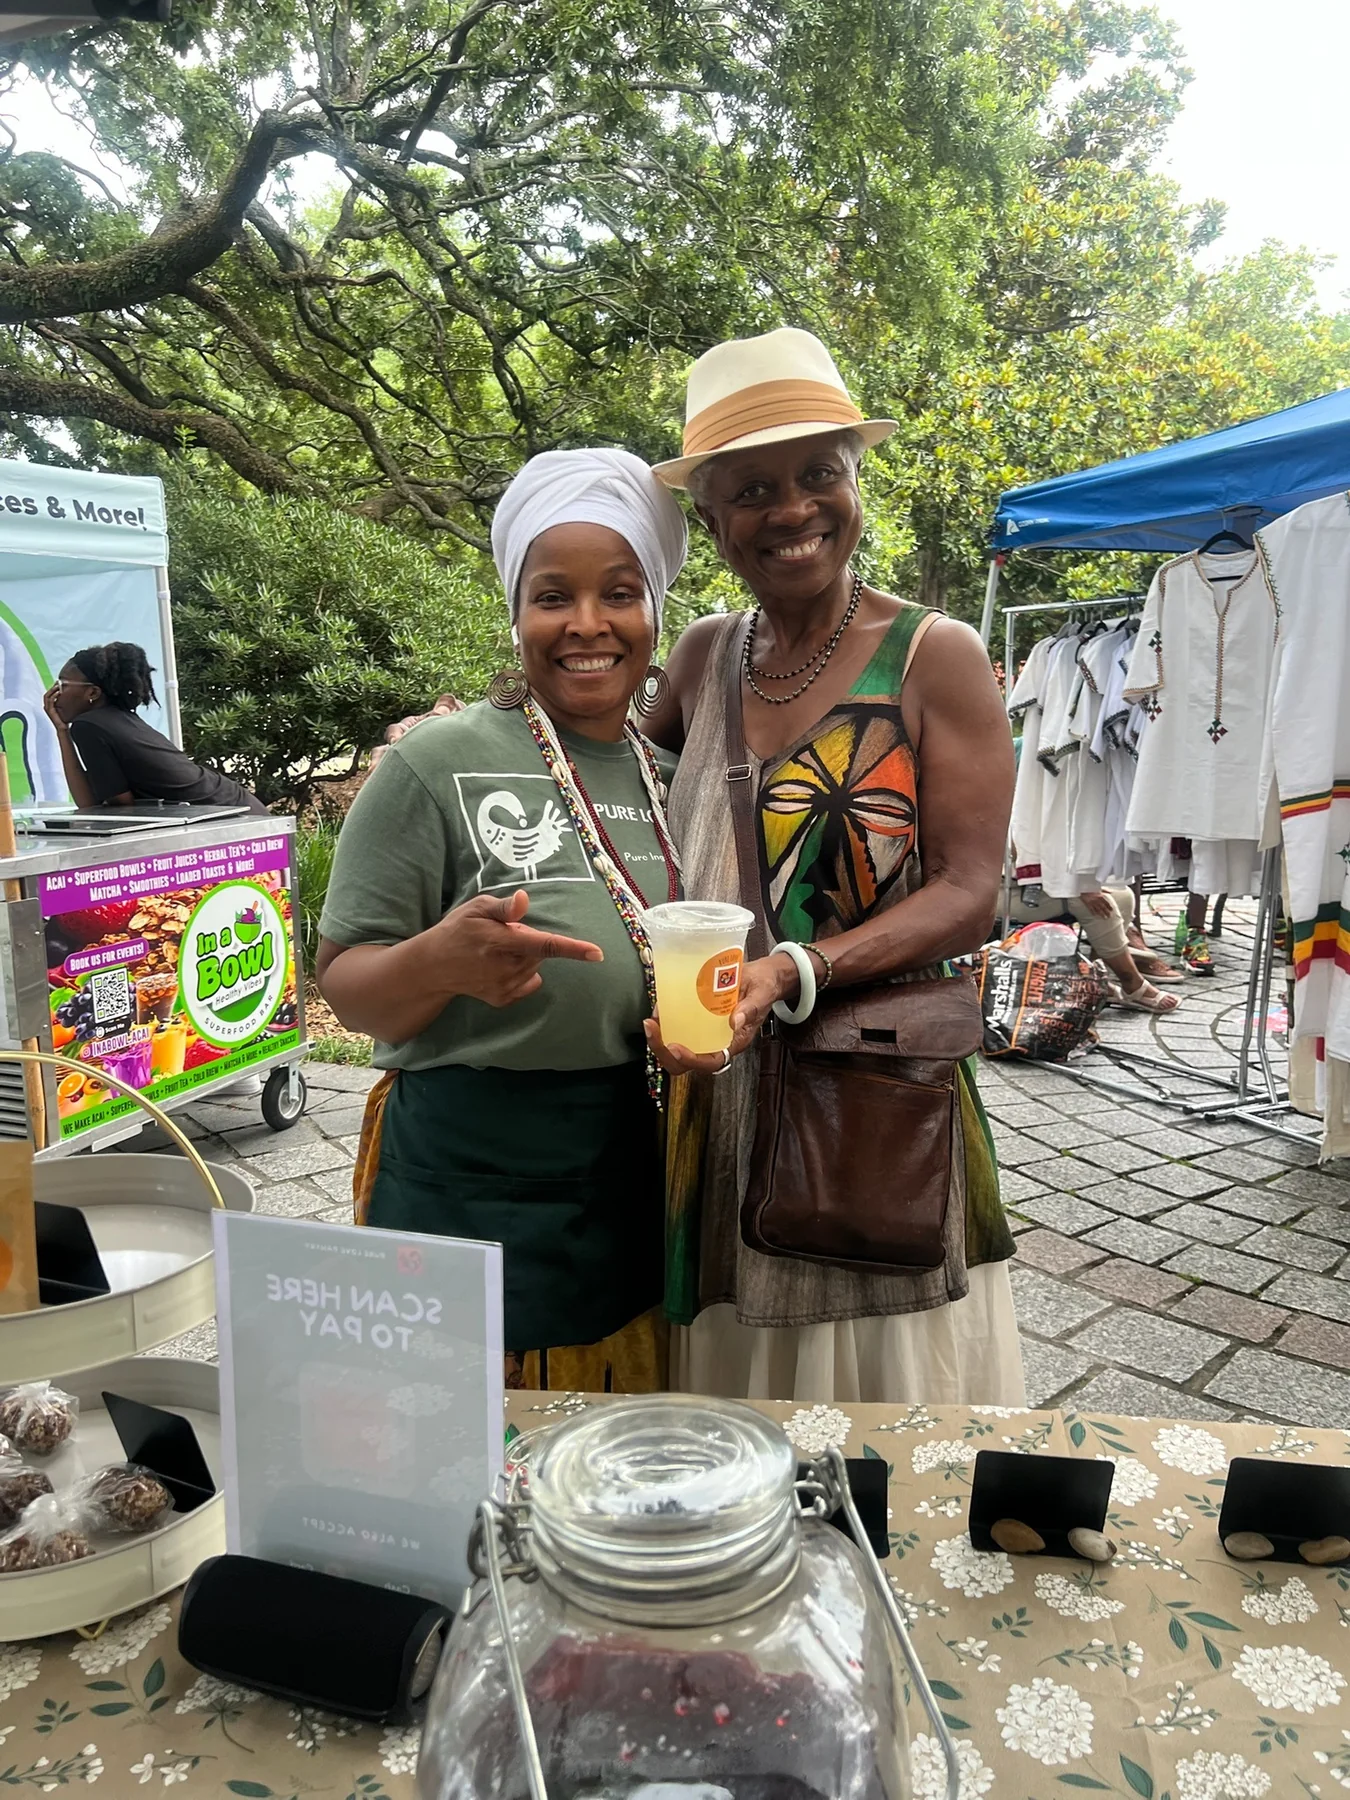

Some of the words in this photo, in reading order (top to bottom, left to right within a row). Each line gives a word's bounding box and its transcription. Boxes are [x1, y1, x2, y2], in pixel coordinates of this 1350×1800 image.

[46, 495, 66, 518] &
[72, 499, 147, 531] More!
[593, 803, 638, 821] PURE
[46, 875, 67, 891] ACAI
[74, 865, 119, 886] SUPERFOOD
[119, 861, 147, 878] BOWLS
[153, 857, 173, 872] FRUIT
[174, 853, 198, 868] JUICES
[203, 848, 228, 863] HERBAL
[624, 852, 648, 862] Pure
[89, 884, 122, 902] MATCHA
[129, 875, 170, 894] SMOOTHIES
[176, 869, 201, 884] LOADED
[202, 865, 226, 879] TOASTS
[228, 862, 233, 874] &
[70, 958, 90, 972] BOOK
[90, 954, 101, 966] US
[102, 950, 116, 963] FOR
[117, 942, 144, 959] EVENTS!
[197, 932, 217, 957] In
[220, 926, 231, 948] a
[197, 931, 274, 1001] Bowl
[205, 1017, 257, 1035] SUPERFOOD
[260, 995, 273, 1016] BAR
[986, 960, 1012, 1046] Marshalls
[63, 1123, 73, 1134] WE
[73, 1117, 90, 1128] MAKE
